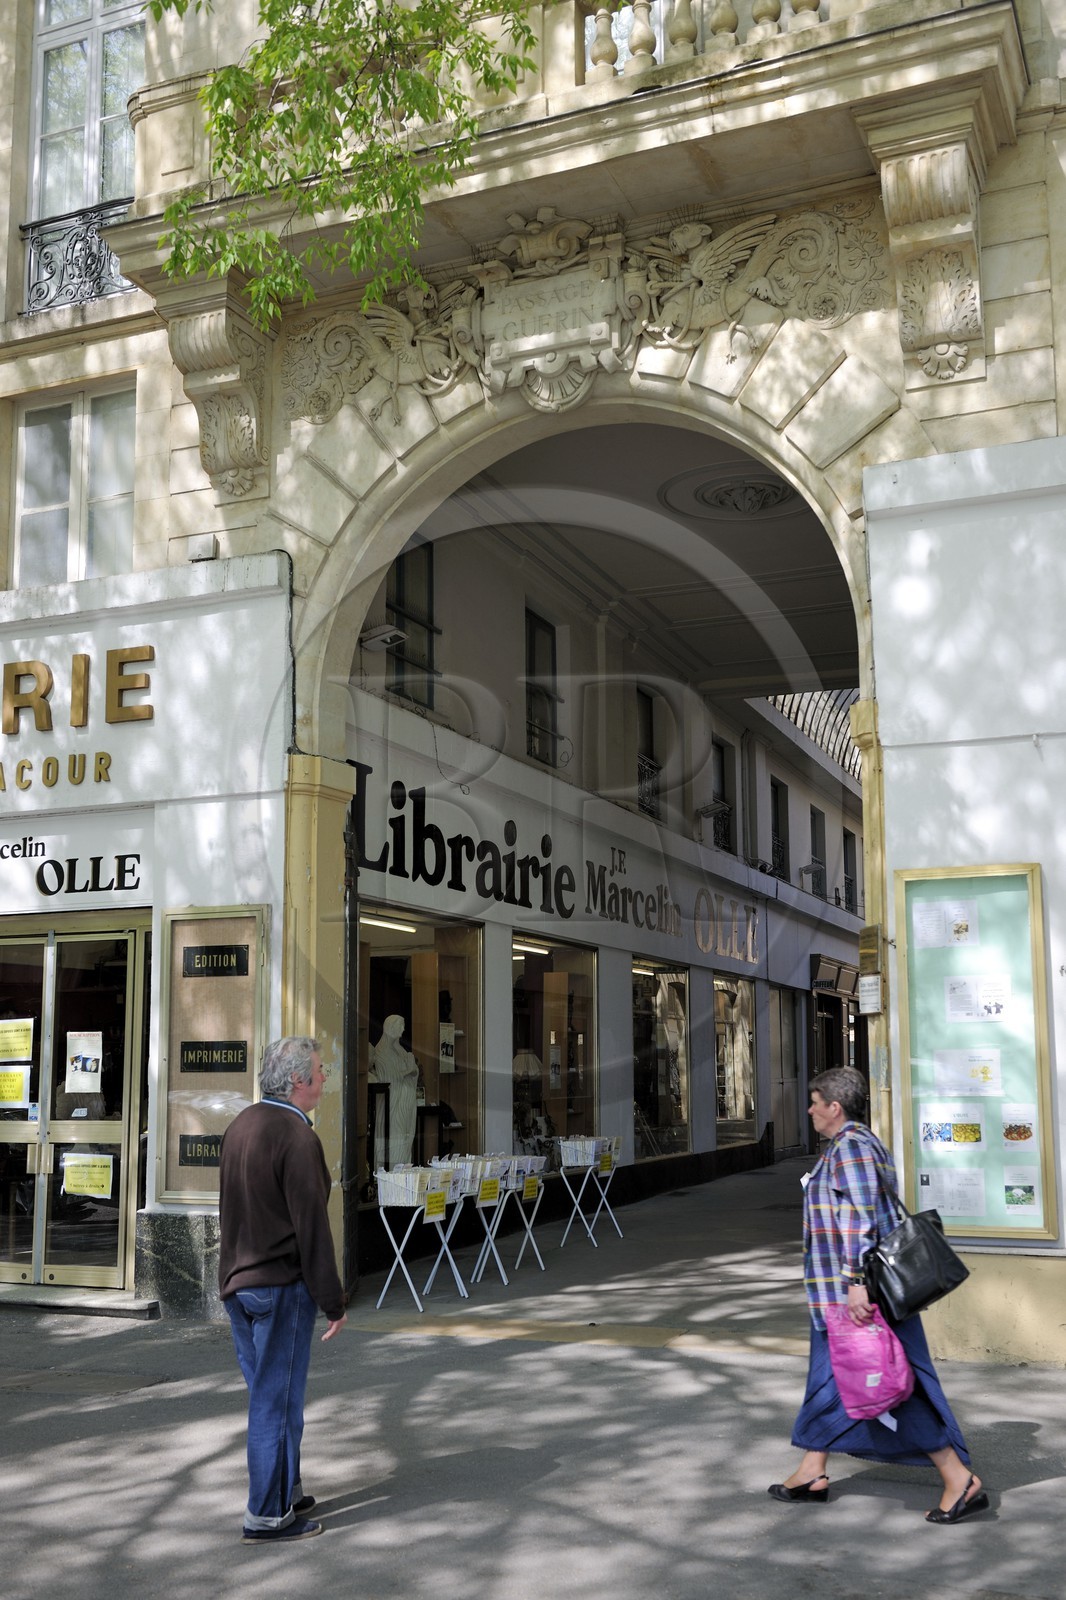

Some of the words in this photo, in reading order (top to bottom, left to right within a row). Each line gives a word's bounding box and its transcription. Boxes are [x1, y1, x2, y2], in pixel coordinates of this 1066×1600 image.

[500, 279, 596, 316] PASSAGE
[502, 305, 595, 342] GUERIN
[1, 645, 155, 735] RIE
[0, 836, 46, 860] celin
[346, 759, 576, 919] Librairie
[37, 854, 141, 896] OLLE
[585, 859, 683, 938] Marcelin
[694, 888, 760, 965] OLLE
[194, 953, 237, 968] EDITION
[184, 1049, 244, 1063] IMPRIMERIE
